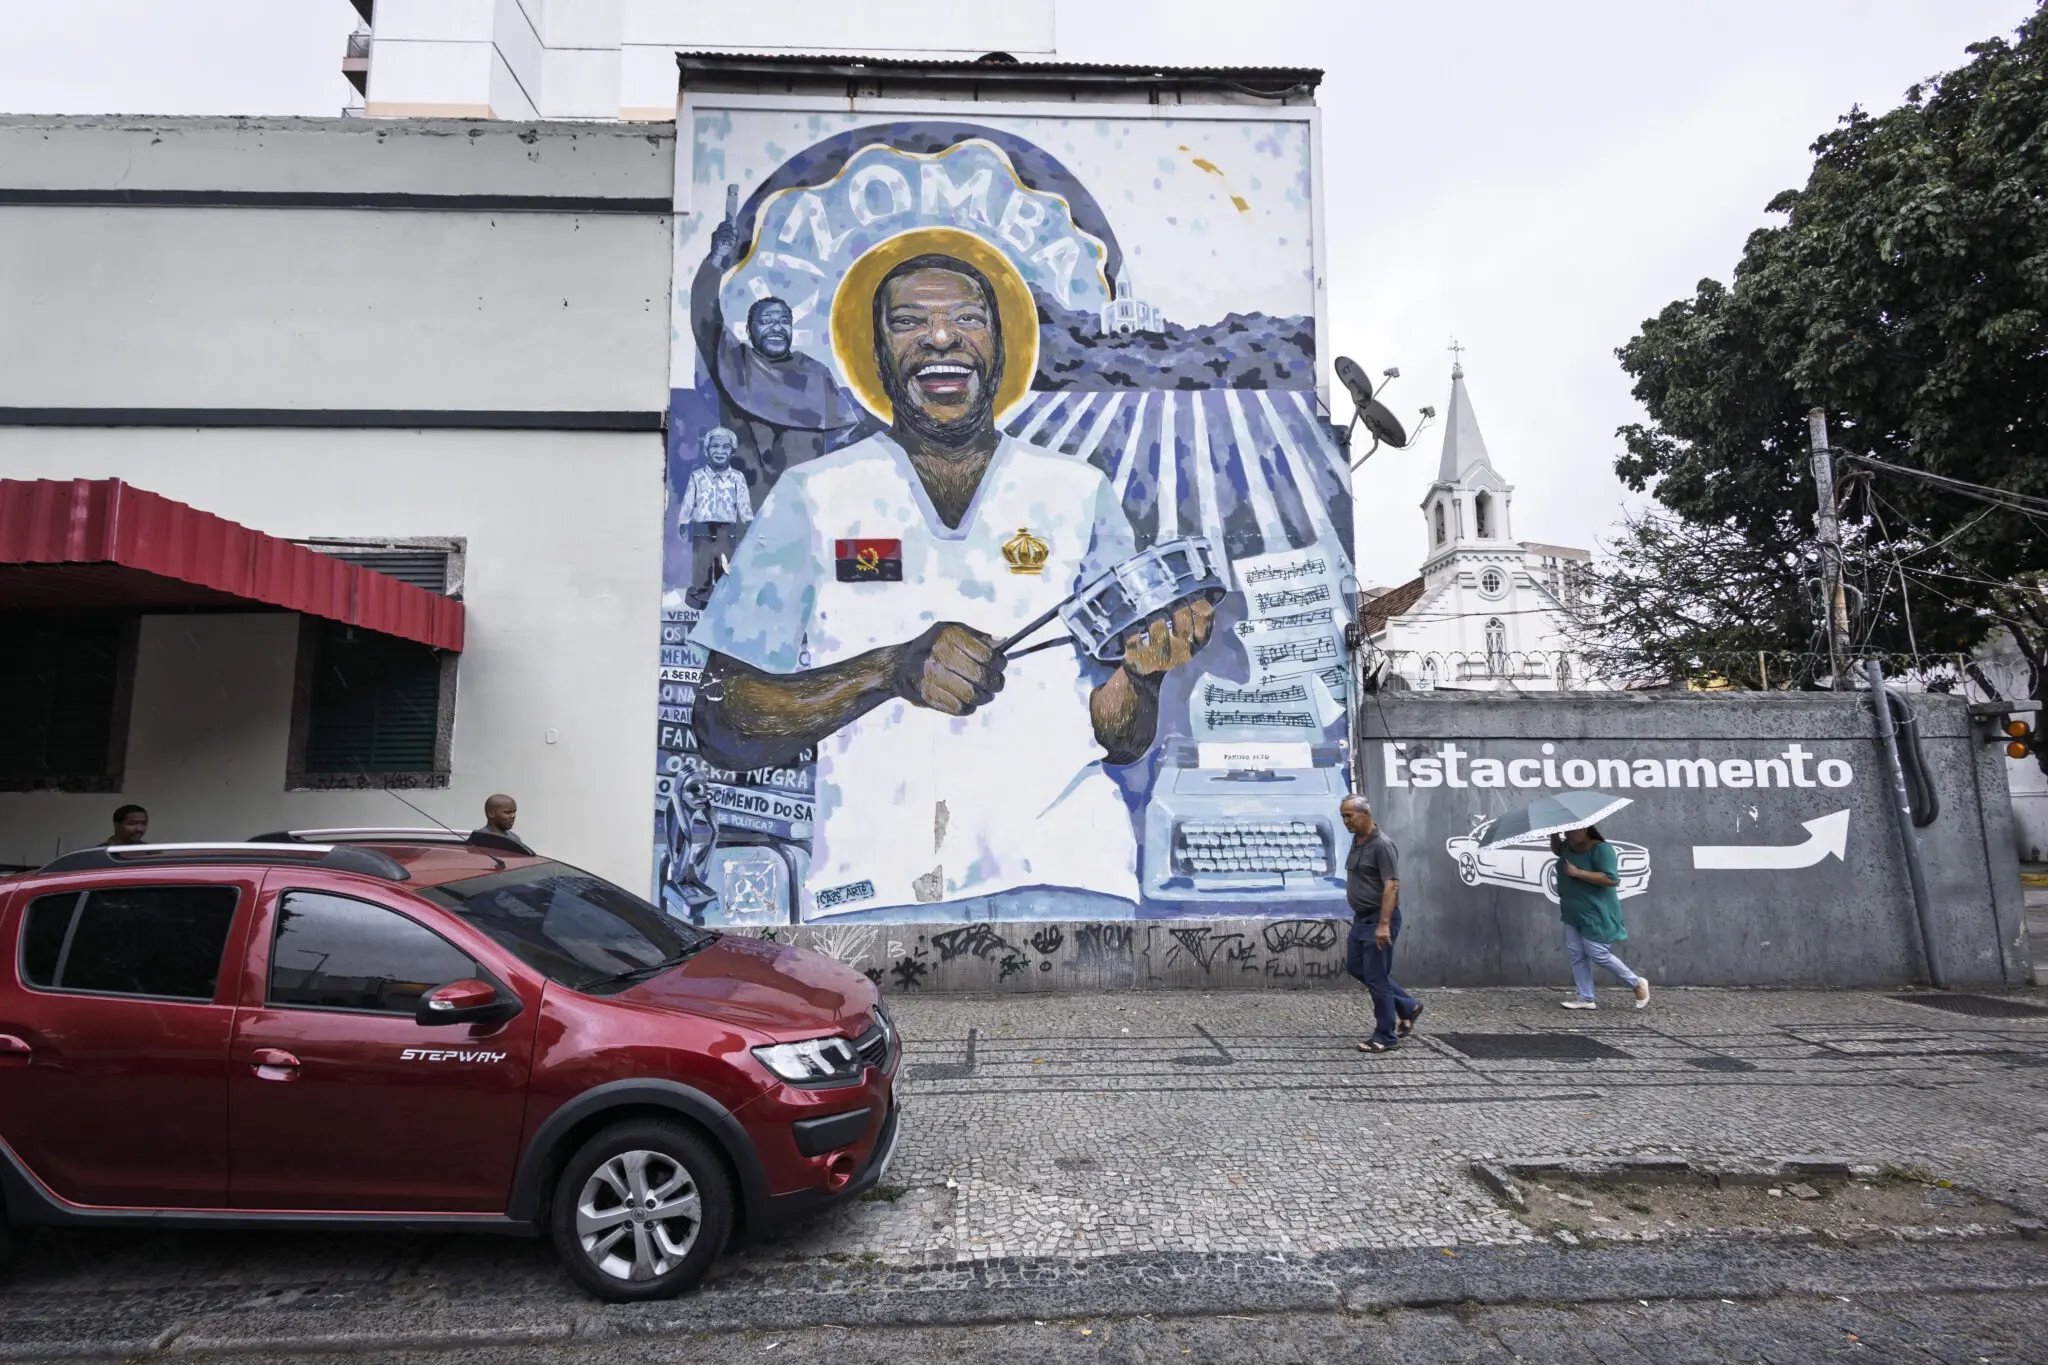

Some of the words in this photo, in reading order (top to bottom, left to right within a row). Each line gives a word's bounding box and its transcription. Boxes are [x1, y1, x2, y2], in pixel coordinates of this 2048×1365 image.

[664, 627, 681, 641] OS
[661, 669, 669, 679] A
[662, 708, 669, 719] A
[1383, 742, 1854, 788] Estacionamento
[400, 1048, 507, 1063] STEPWAY
